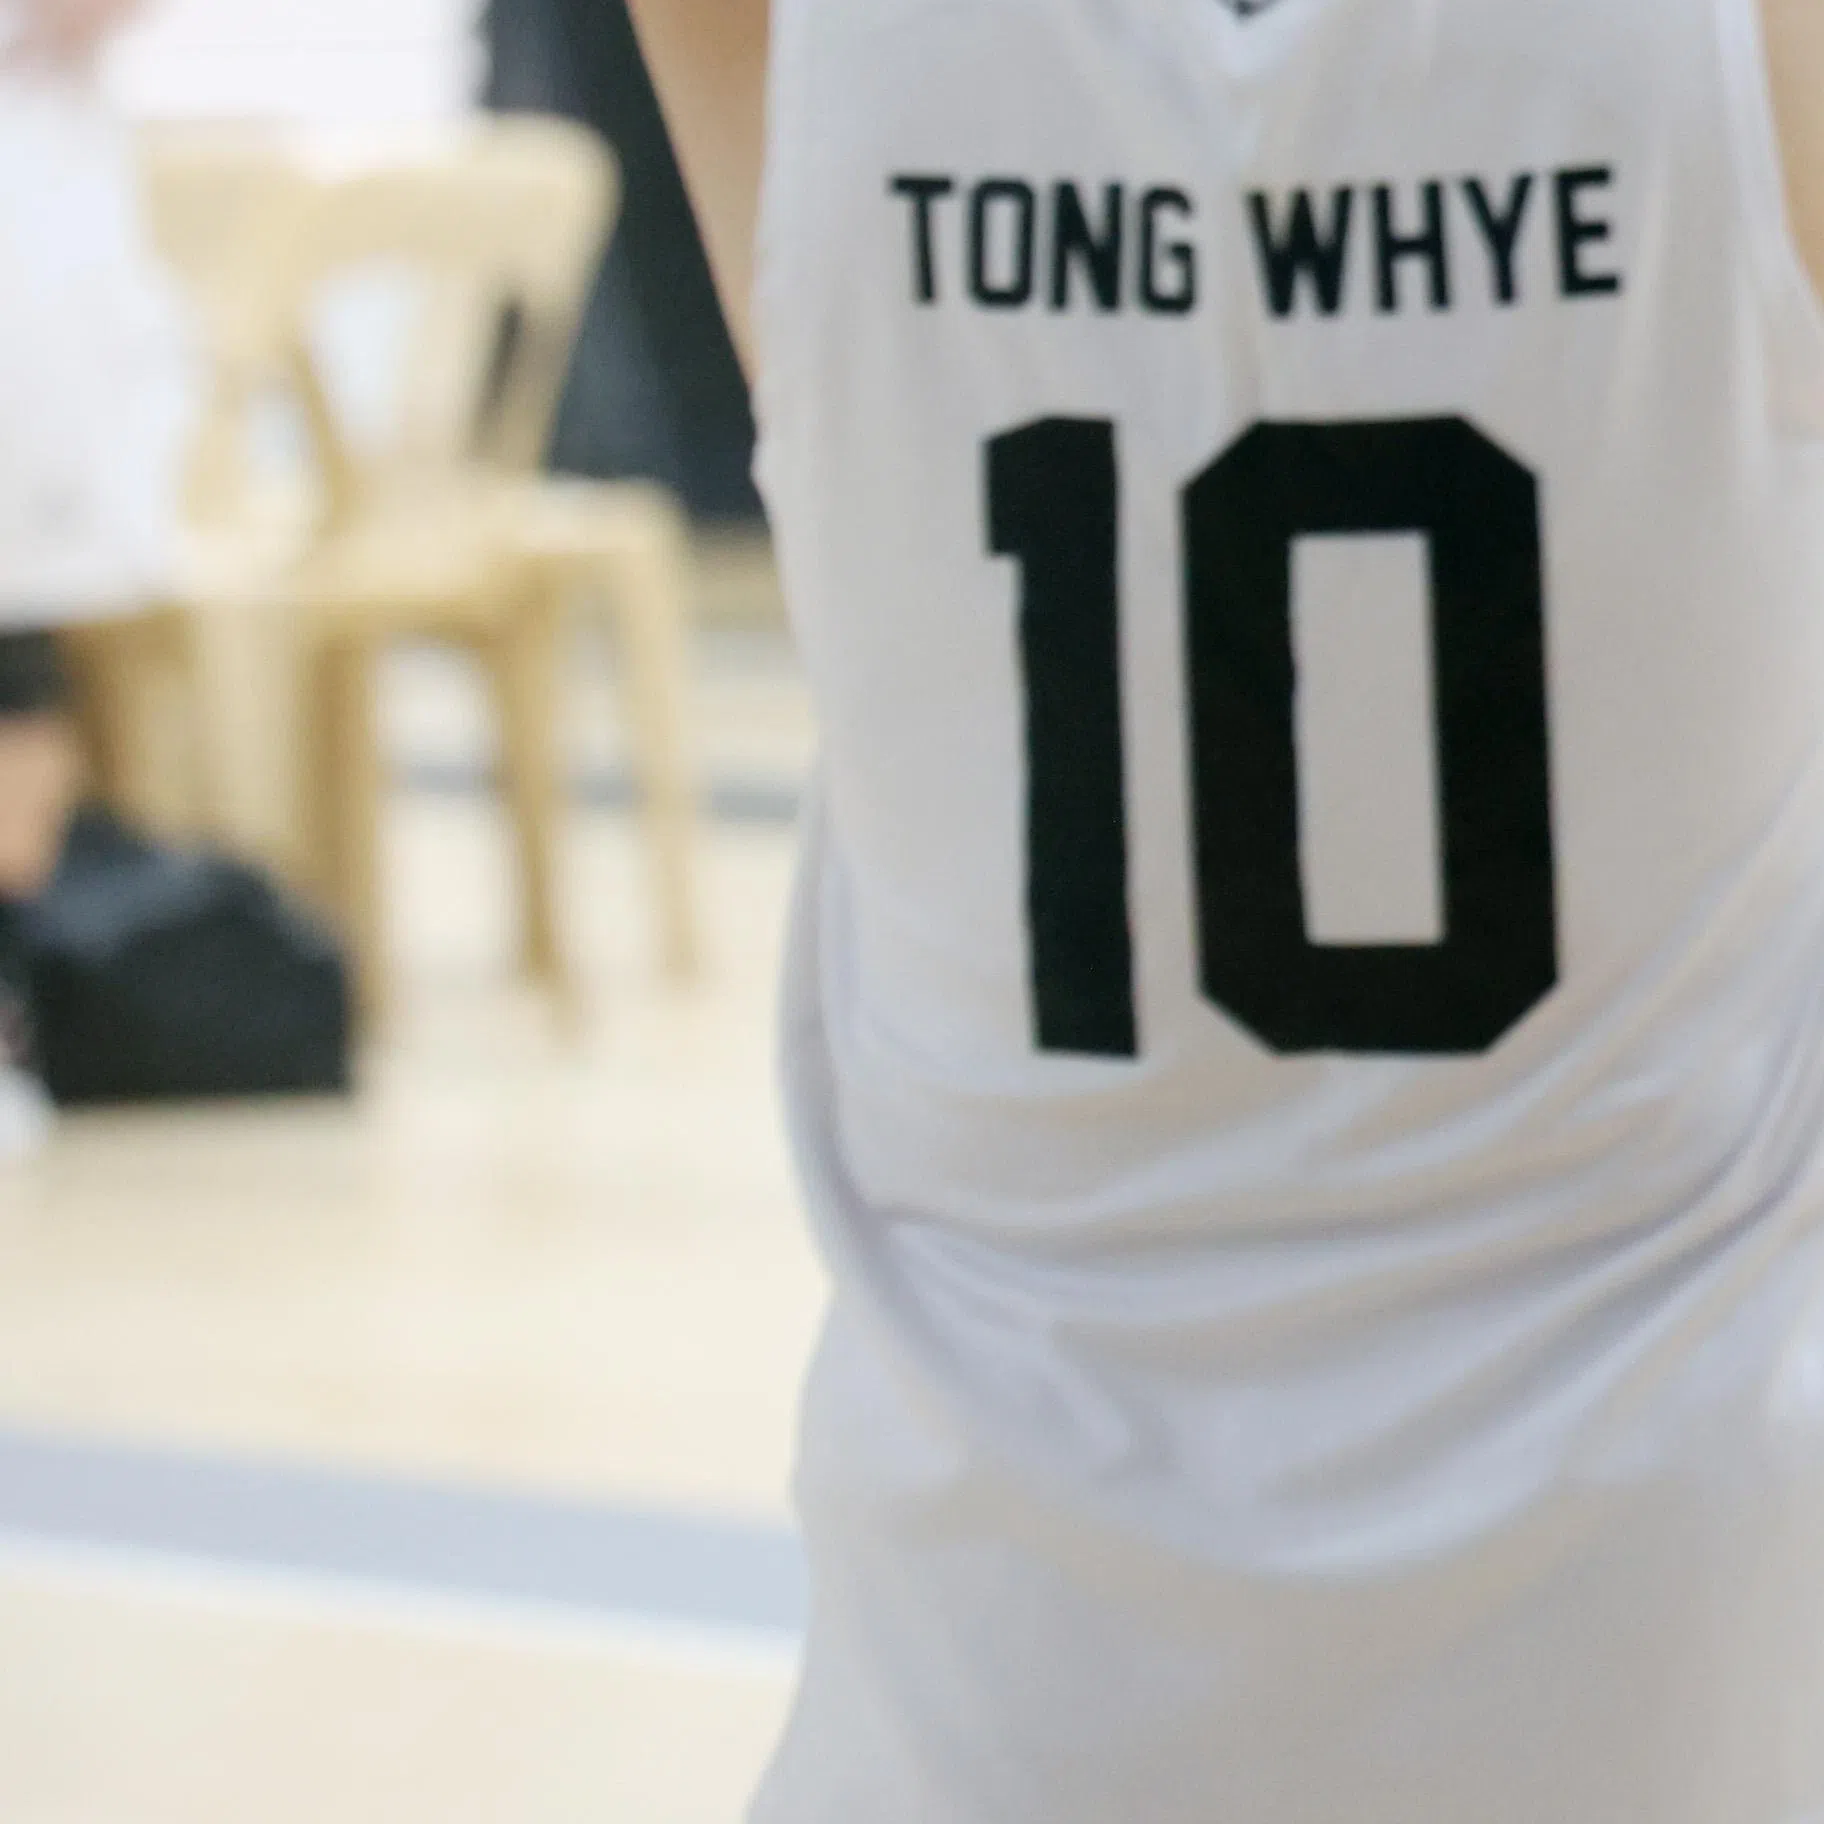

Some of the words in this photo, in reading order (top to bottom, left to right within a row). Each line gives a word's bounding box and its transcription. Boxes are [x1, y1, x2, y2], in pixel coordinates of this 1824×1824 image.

[889, 174, 1198, 316] TONG
[1247, 165, 1622, 319] WHYE
[983, 412, 1561, 1061] 10
